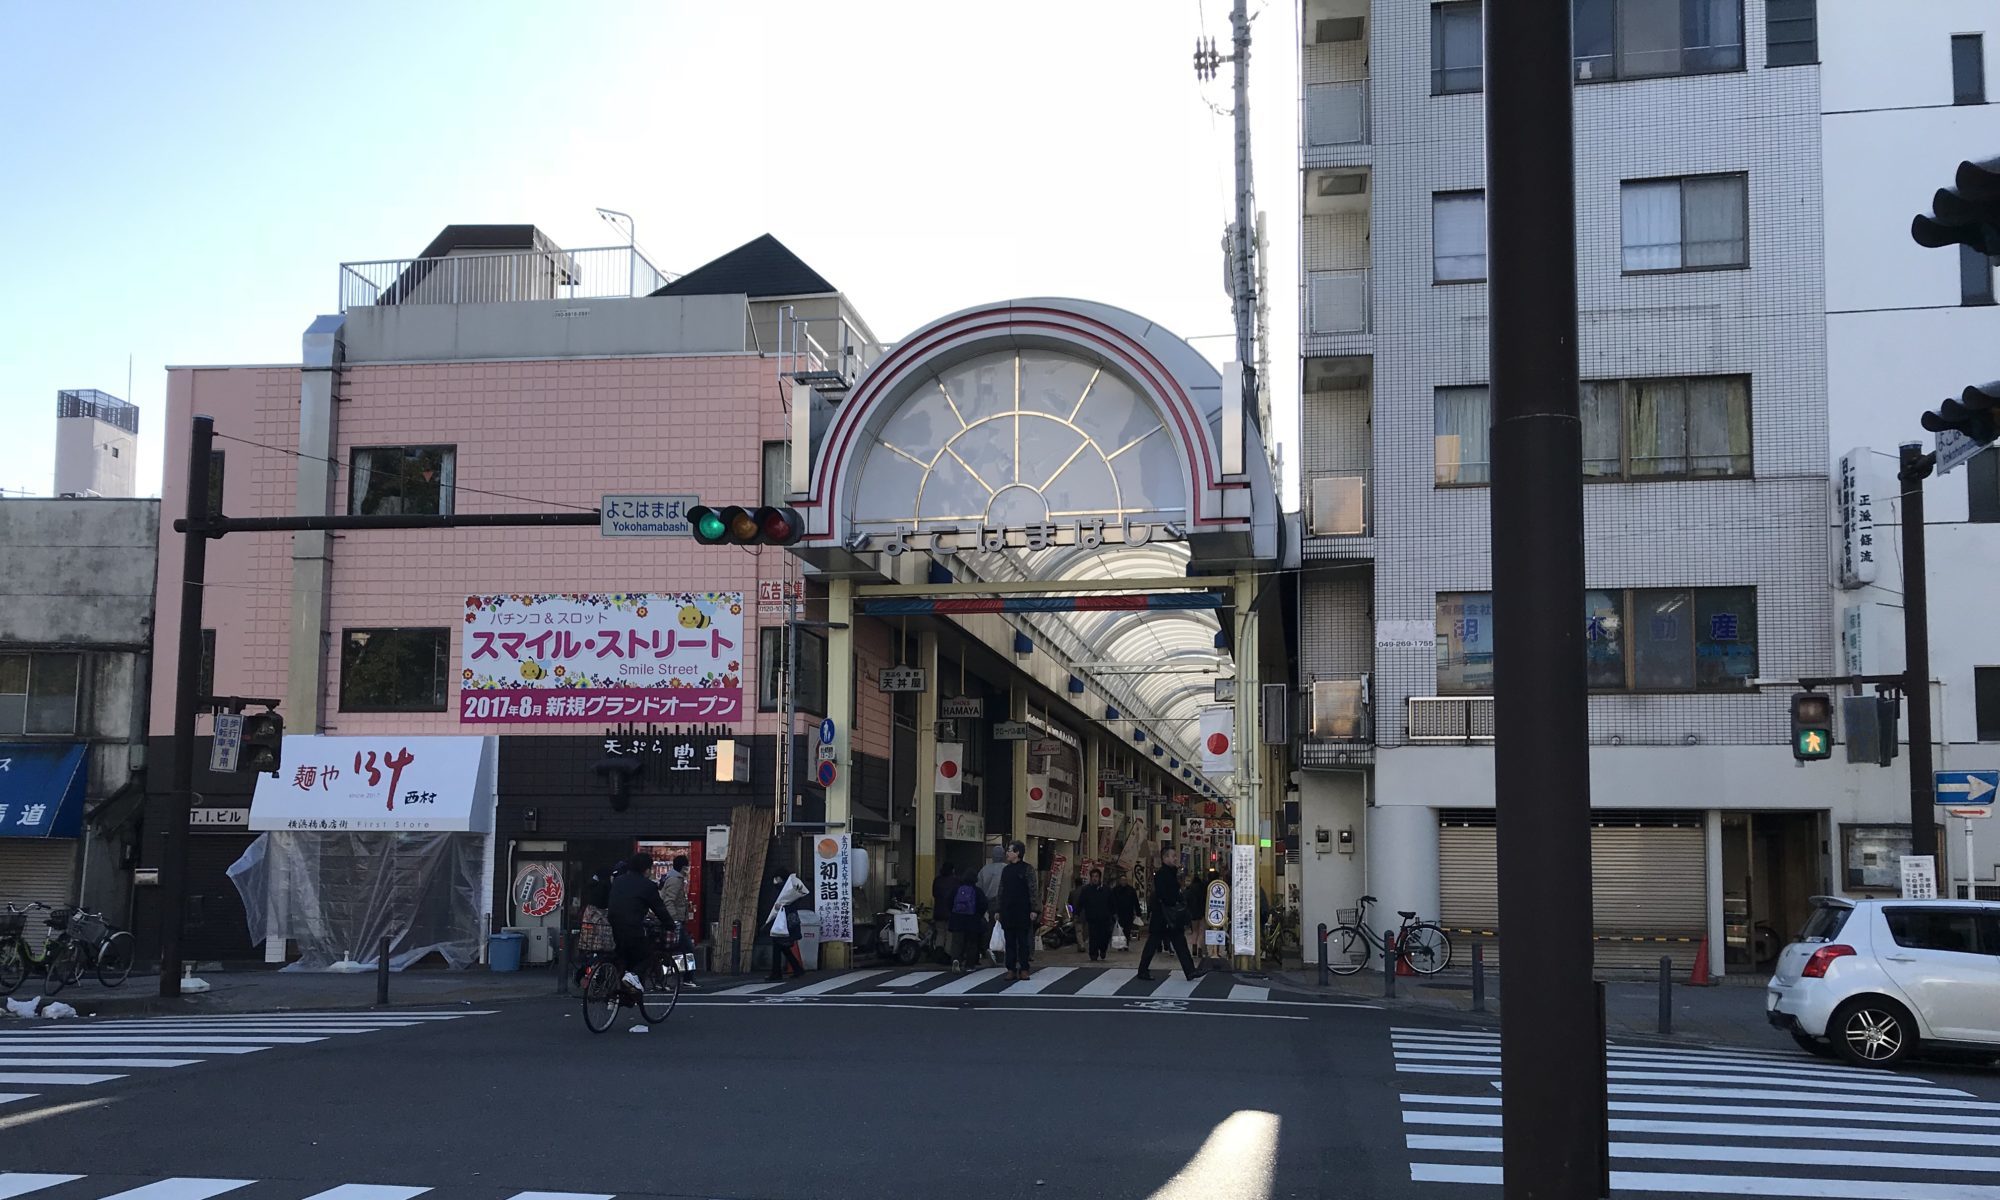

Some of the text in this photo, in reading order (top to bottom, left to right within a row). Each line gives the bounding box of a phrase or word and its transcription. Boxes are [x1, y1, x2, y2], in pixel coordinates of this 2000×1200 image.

[612, 521, 689, 532] Yokohamabashi
[470, 628, 734, 660] スマイル・ストリート
[619, 664, 698, 675] Smile Street
[464, 695, 736, 718] 2017年8月 新規グランドオープン
[943, 706, 980, 716] HAMAYA
[217, 719, 228, 747] 自転車
[228, 719, 239, 748] 歩行者
[604, 739, 663, 755] 天ぷら
[404, 790, 437, 805] 西村
[287, 819, 348, 829] 横浜橋商店街
[819, 861, 838, 900] 初詣
